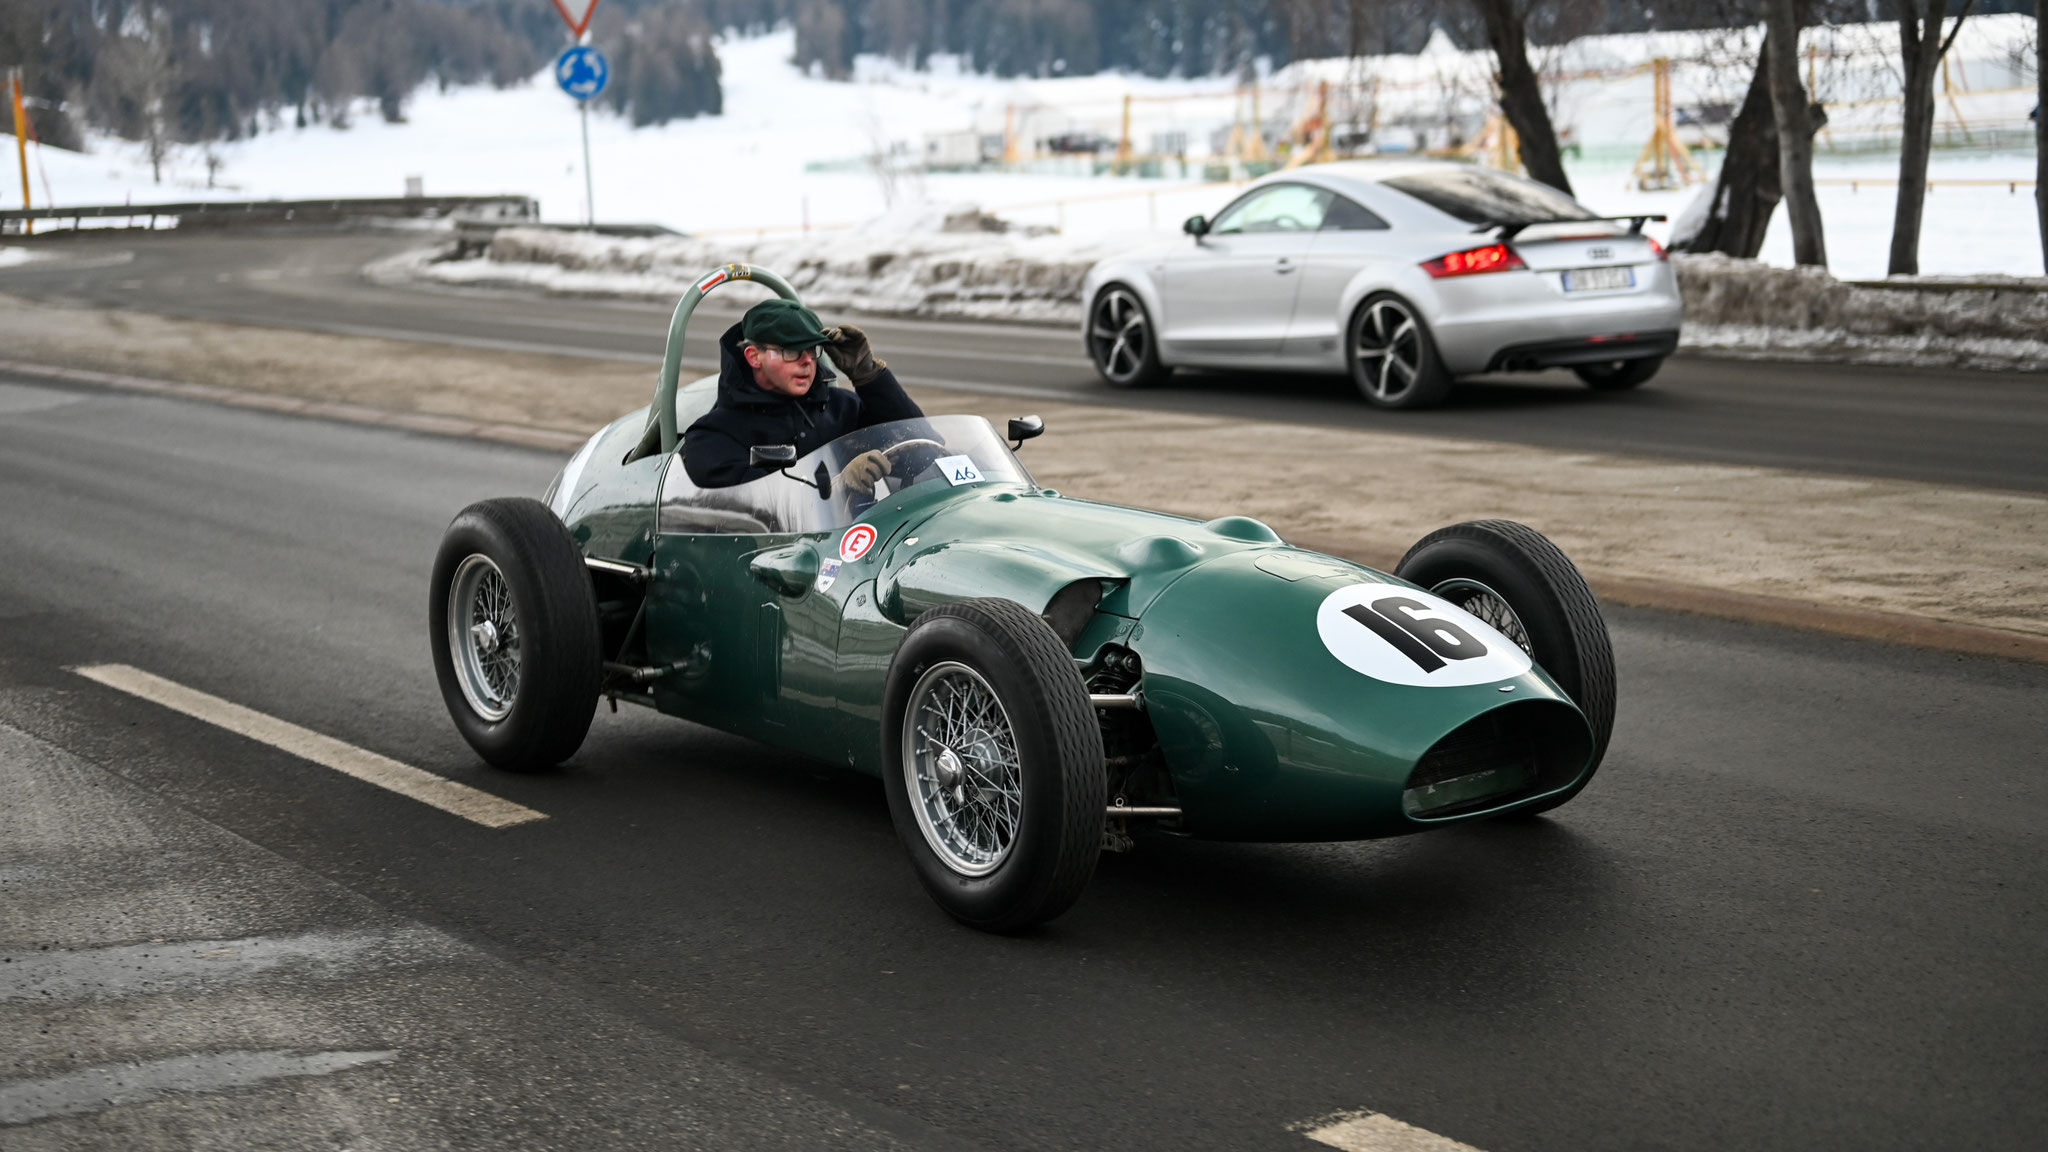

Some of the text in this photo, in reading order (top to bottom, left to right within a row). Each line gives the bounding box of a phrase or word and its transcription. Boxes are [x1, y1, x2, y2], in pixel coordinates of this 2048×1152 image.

[955, 466, 976, 481] 46
[848, 533, 867, 552] E
[1341, 596, 1488, 674] 16
